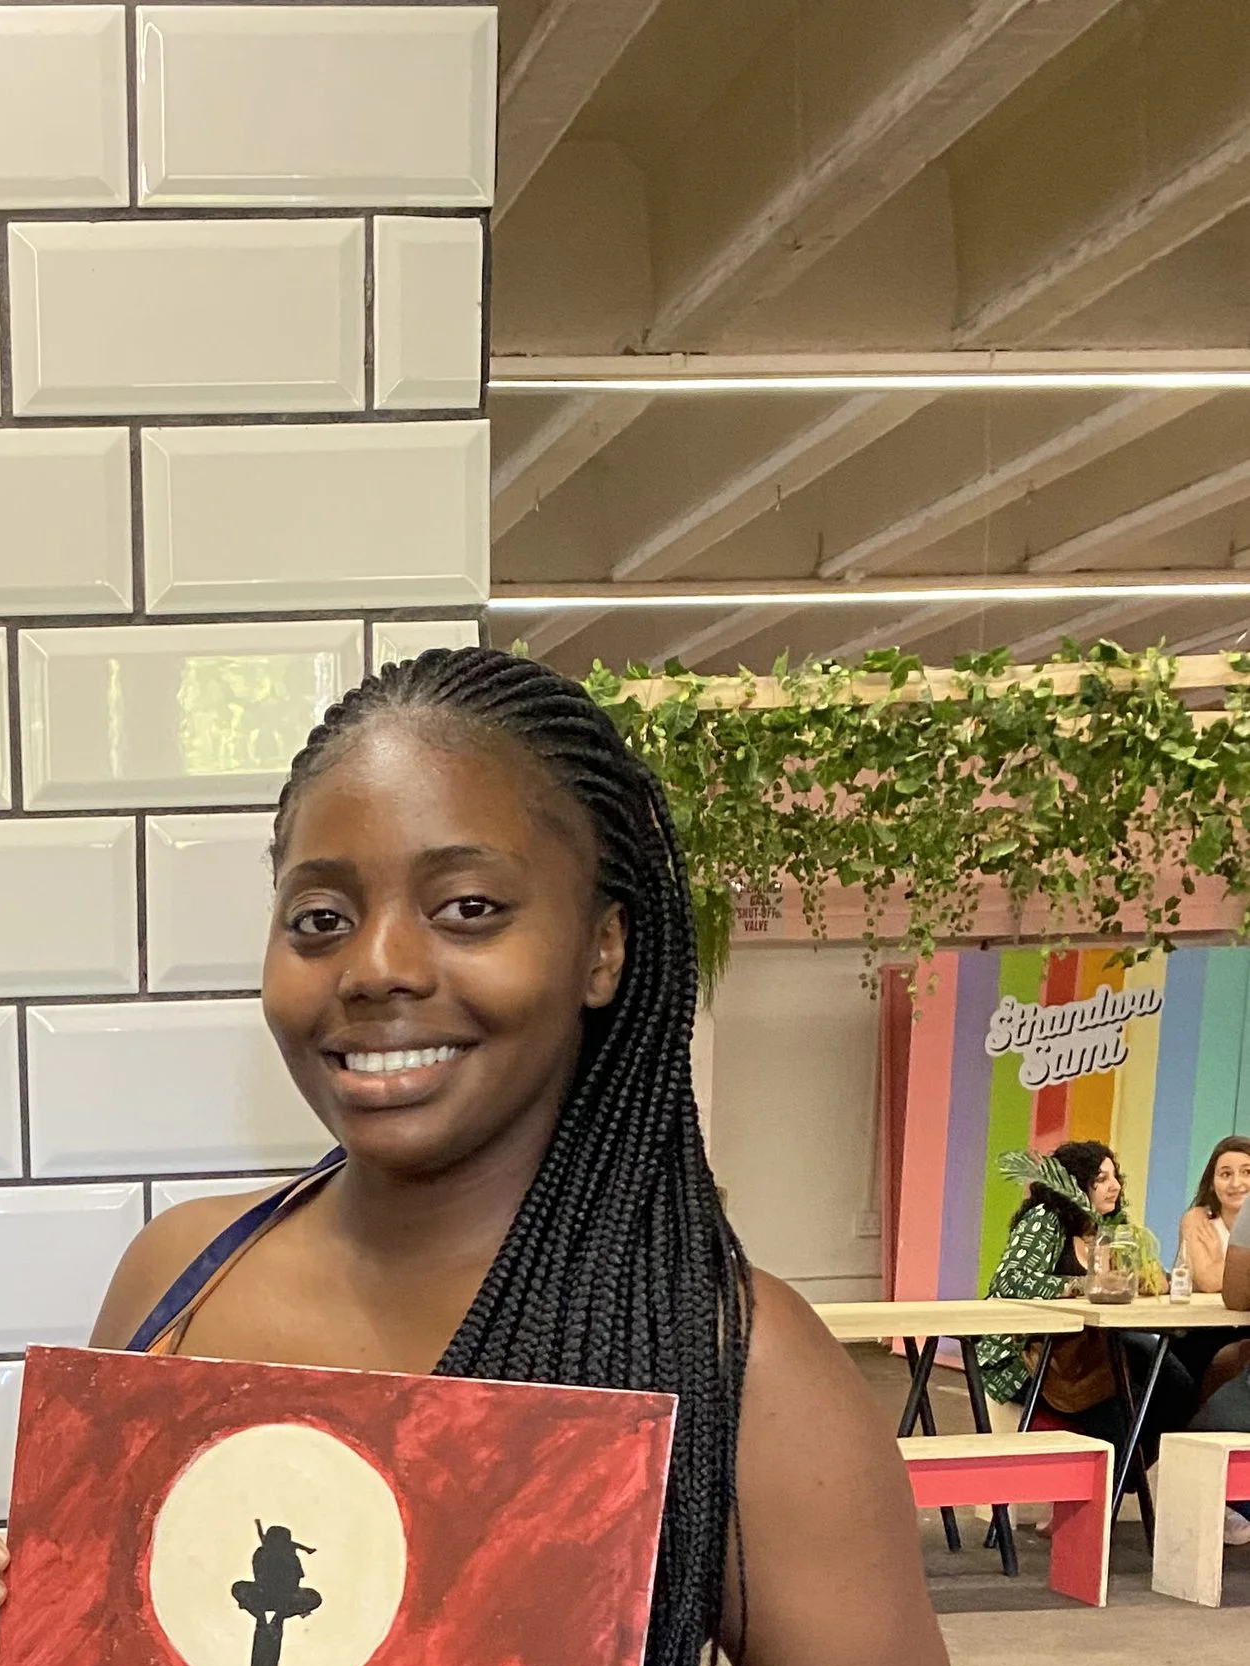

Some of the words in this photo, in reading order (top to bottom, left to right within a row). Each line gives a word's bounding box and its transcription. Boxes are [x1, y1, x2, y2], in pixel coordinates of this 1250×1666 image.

[737, 907, 776, 919] SHUT-OFF
[744, 920, 768, 931] VALVE
[988, 987, 1163, 1052] Sthandwa
[1023, 1024, 1129, 1086] Sami
